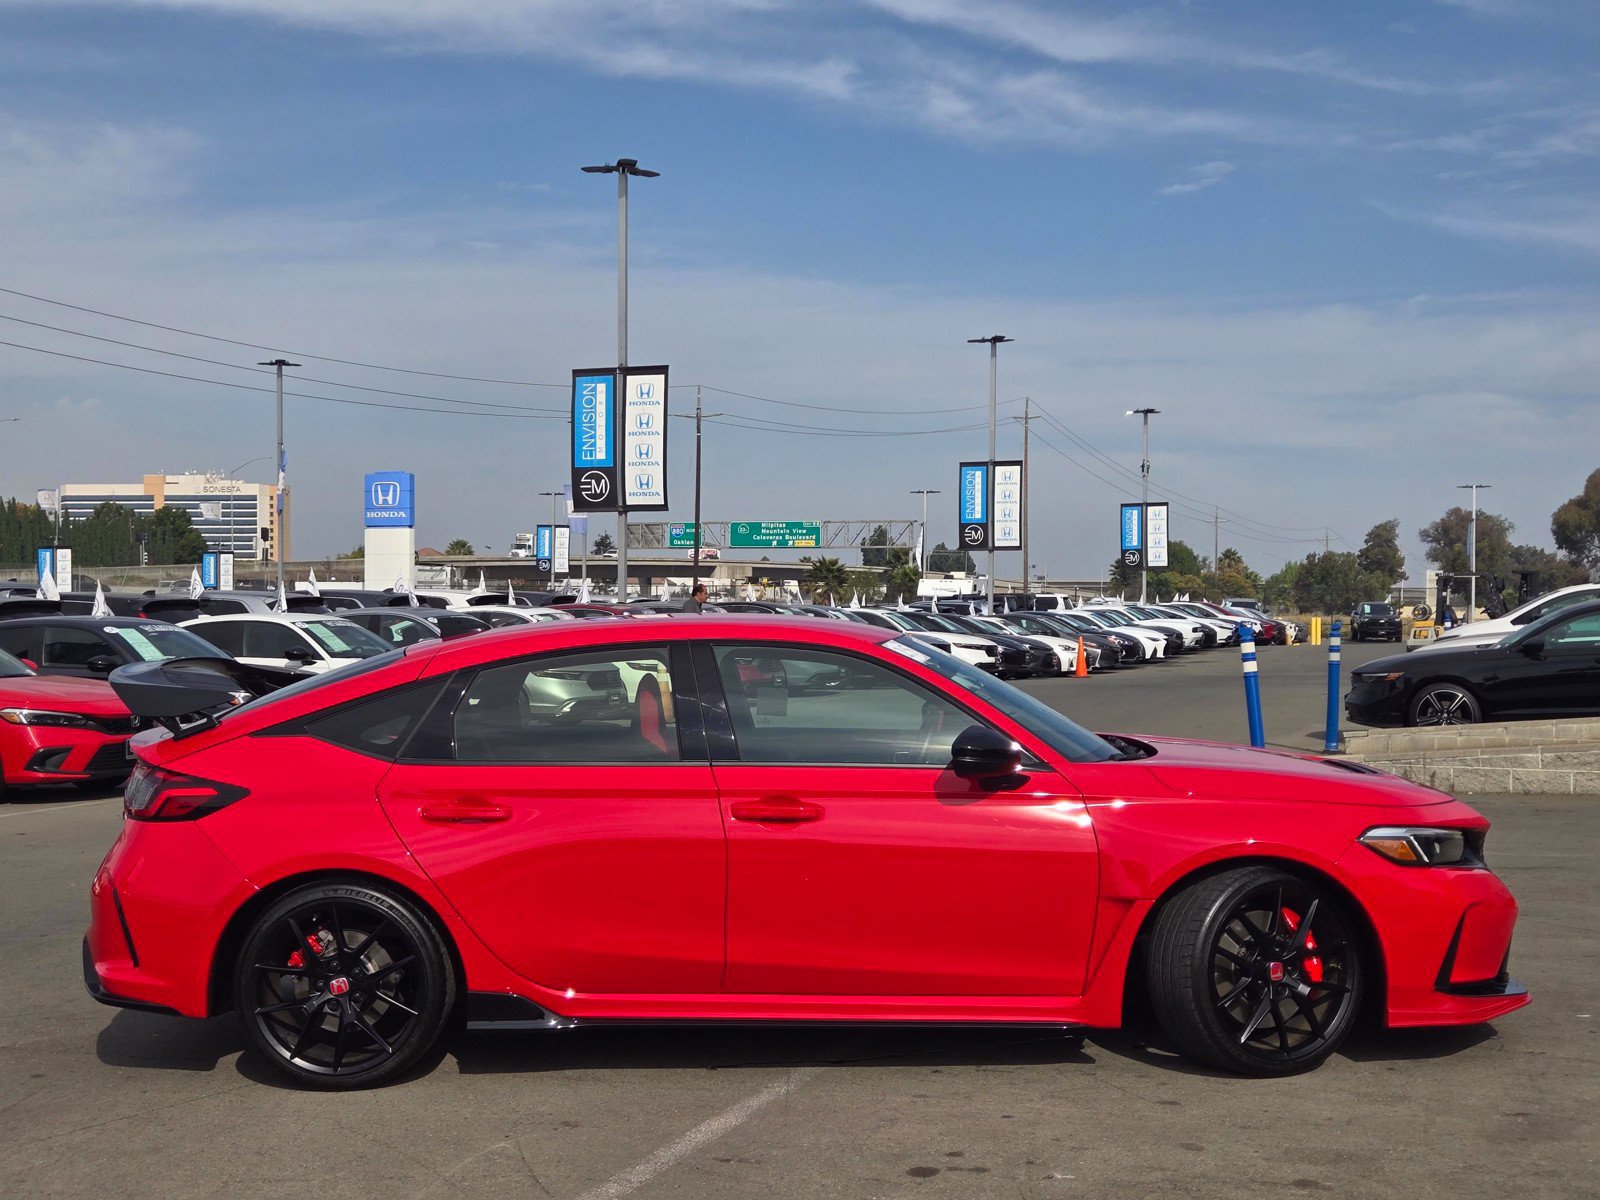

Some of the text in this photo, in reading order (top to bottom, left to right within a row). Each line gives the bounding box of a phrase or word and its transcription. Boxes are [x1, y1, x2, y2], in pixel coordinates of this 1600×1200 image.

[582, 383, 596, 460] ENVISION
[203, 485, 242, 493] SONESTA
[965, 470, 976, 519] ENVISION
[1125, 510, 1133, 547] ENVISION
[336, 888, 389, 908] MICHELIN
